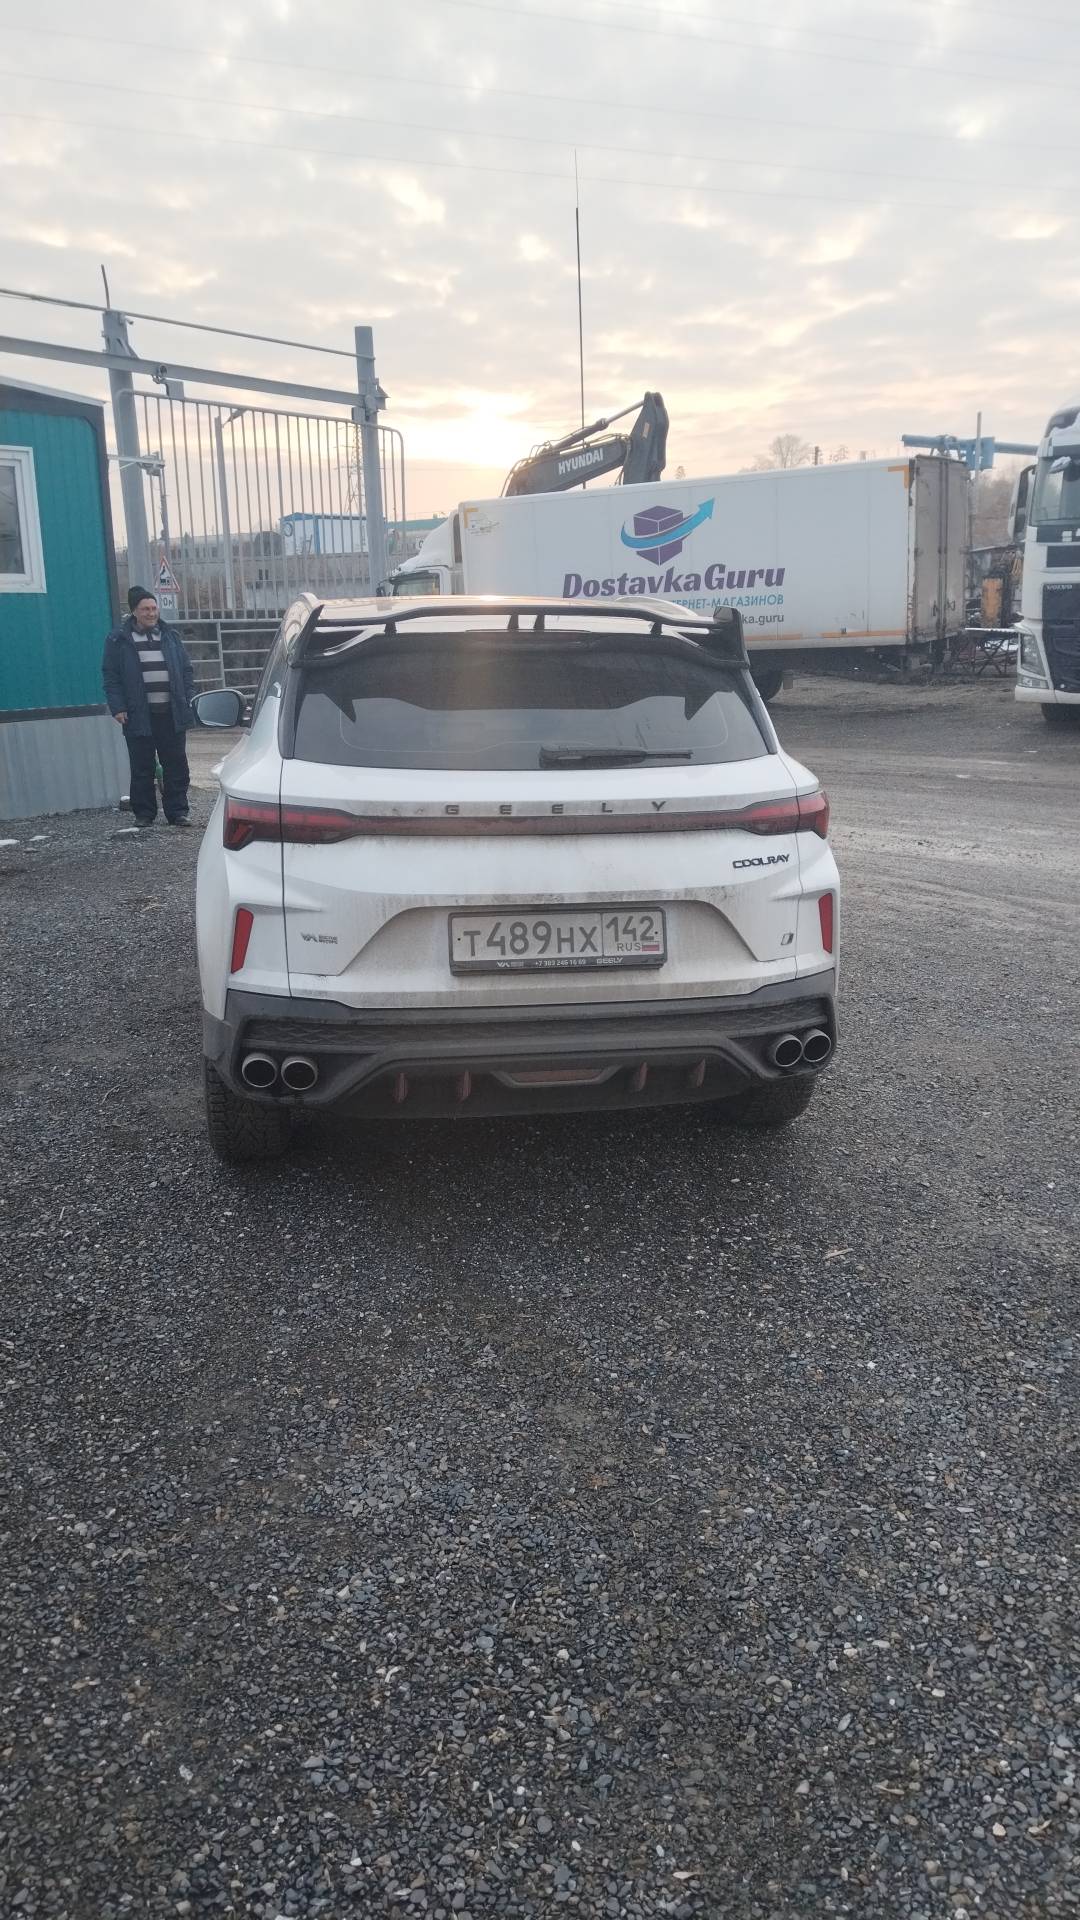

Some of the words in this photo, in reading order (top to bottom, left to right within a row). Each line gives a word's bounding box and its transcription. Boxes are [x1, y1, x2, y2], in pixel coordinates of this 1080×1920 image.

[558, 448, 604, 475] HYUNDAI
[562, 563, 786, 599] DostavkaGuru
[445, 800, 666, 815] GEELY
[732, 854, 790, 869] COOLRAY
[605, 915, 655, 942] 142
[616, 942, 641, 952] RUS
